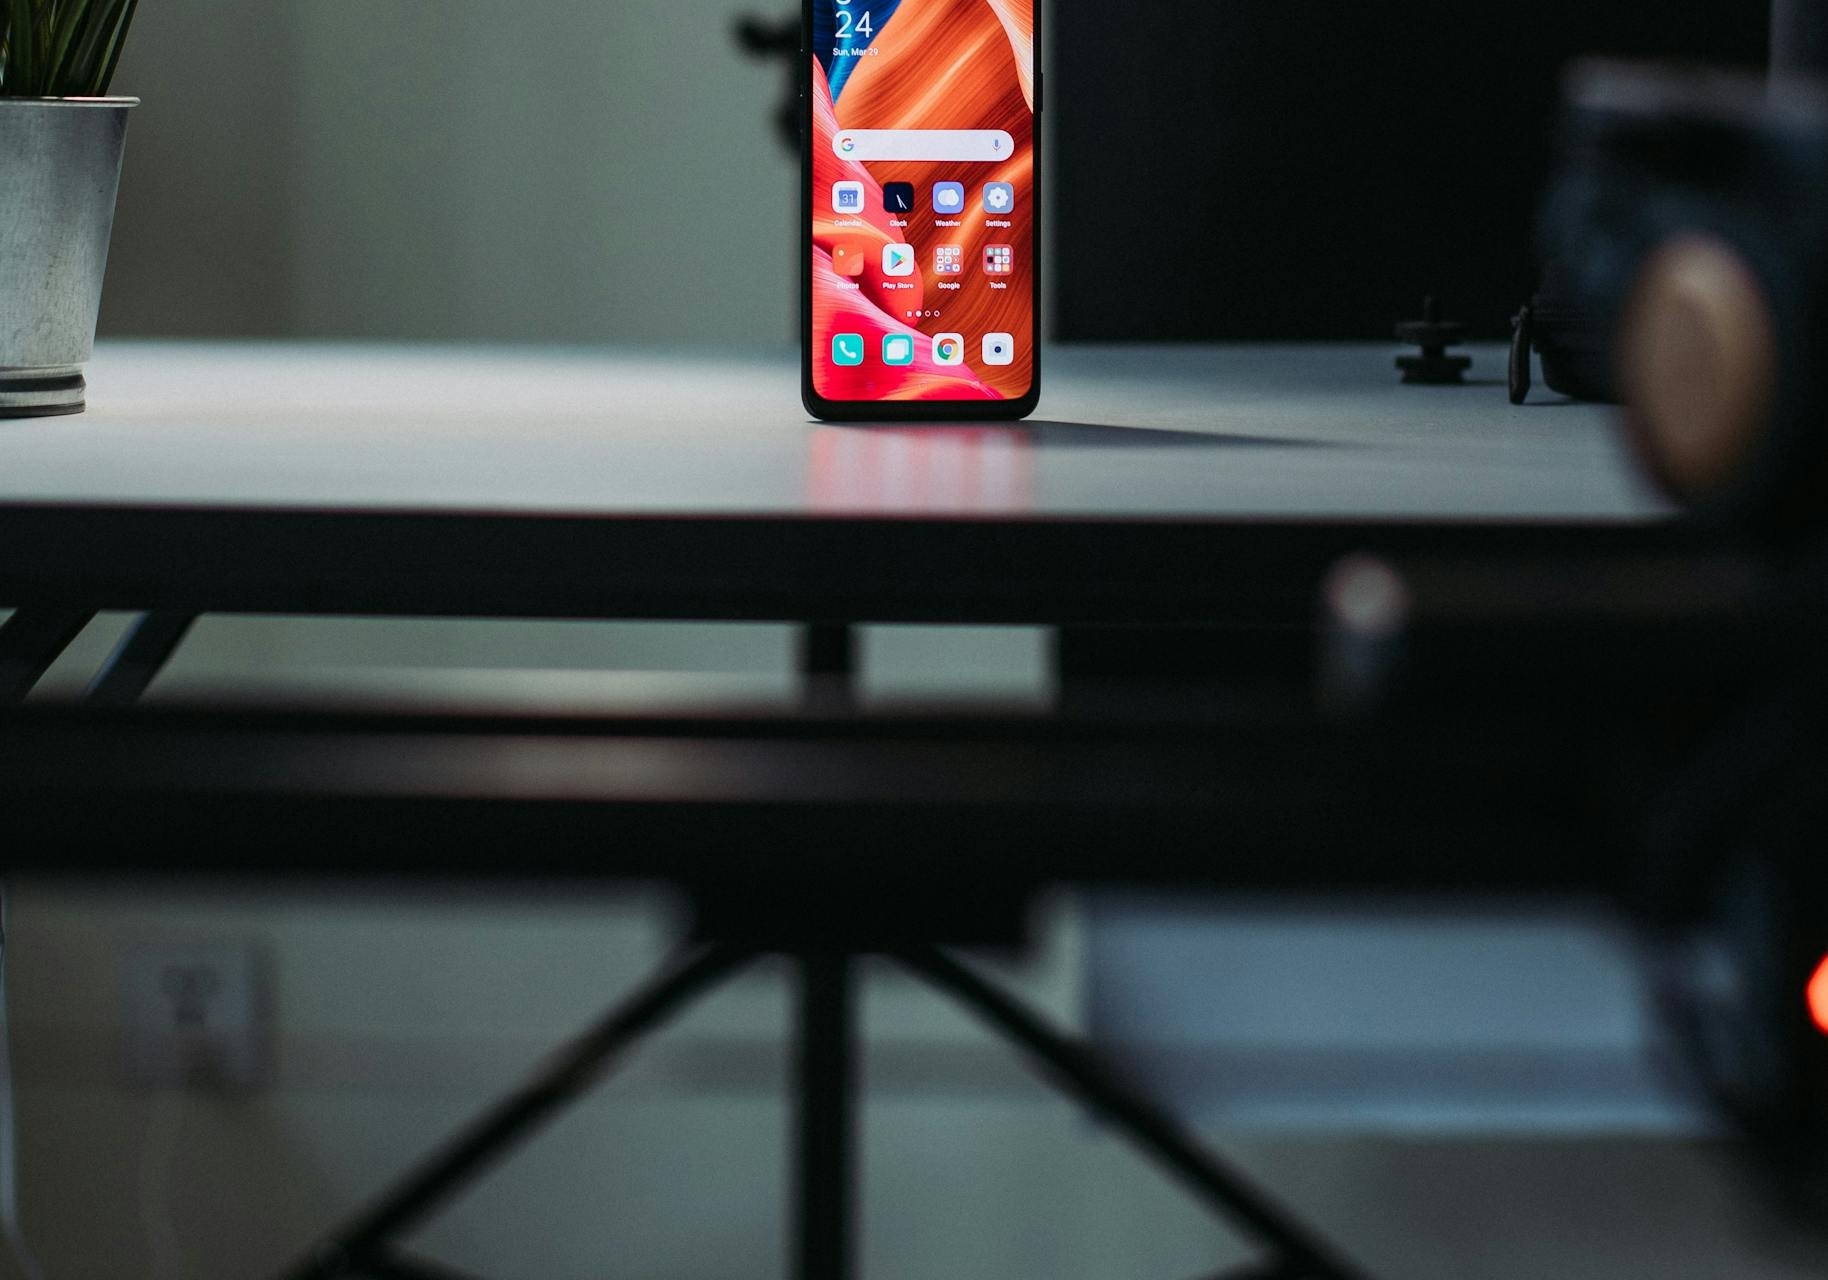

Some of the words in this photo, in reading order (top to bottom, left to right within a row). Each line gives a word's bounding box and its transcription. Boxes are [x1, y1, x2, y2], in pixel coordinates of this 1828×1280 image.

[835, 10, 873, 39] 24
[833, 47, 850, 57] Sun,
[851, 47, 867, 56] Mar
[868, 47, 879, 56] 29
[842, 193, 854, 204] 31
[889, 219, 908, 227] Clock
[935, 219, 961, 227] Weather
[985, 219, 1011, 228] Settings
[882, 281, 897, 290] Play
[897, 281, 914, 289] Store
[938, 281, 960, 290] Google
[989, 281, 1007, 289] Tools
